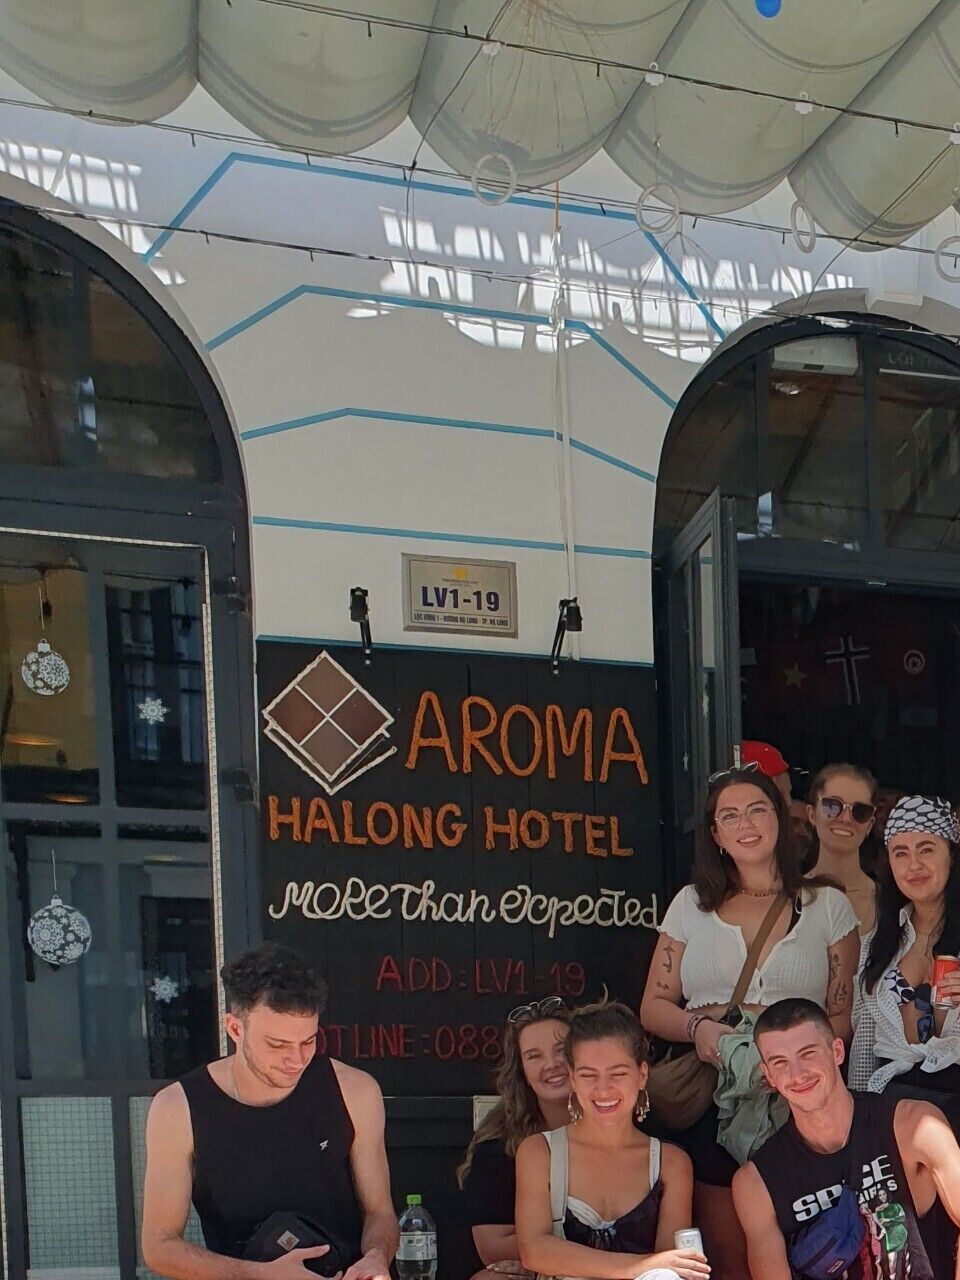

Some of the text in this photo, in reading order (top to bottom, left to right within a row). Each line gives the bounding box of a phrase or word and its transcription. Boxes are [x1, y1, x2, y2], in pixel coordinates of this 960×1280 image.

[421, 586, 500, 612] LV1-19
[404, 690, 649, 784] AROMA
[267, 795, 635, 858] HALONG HOTEL
